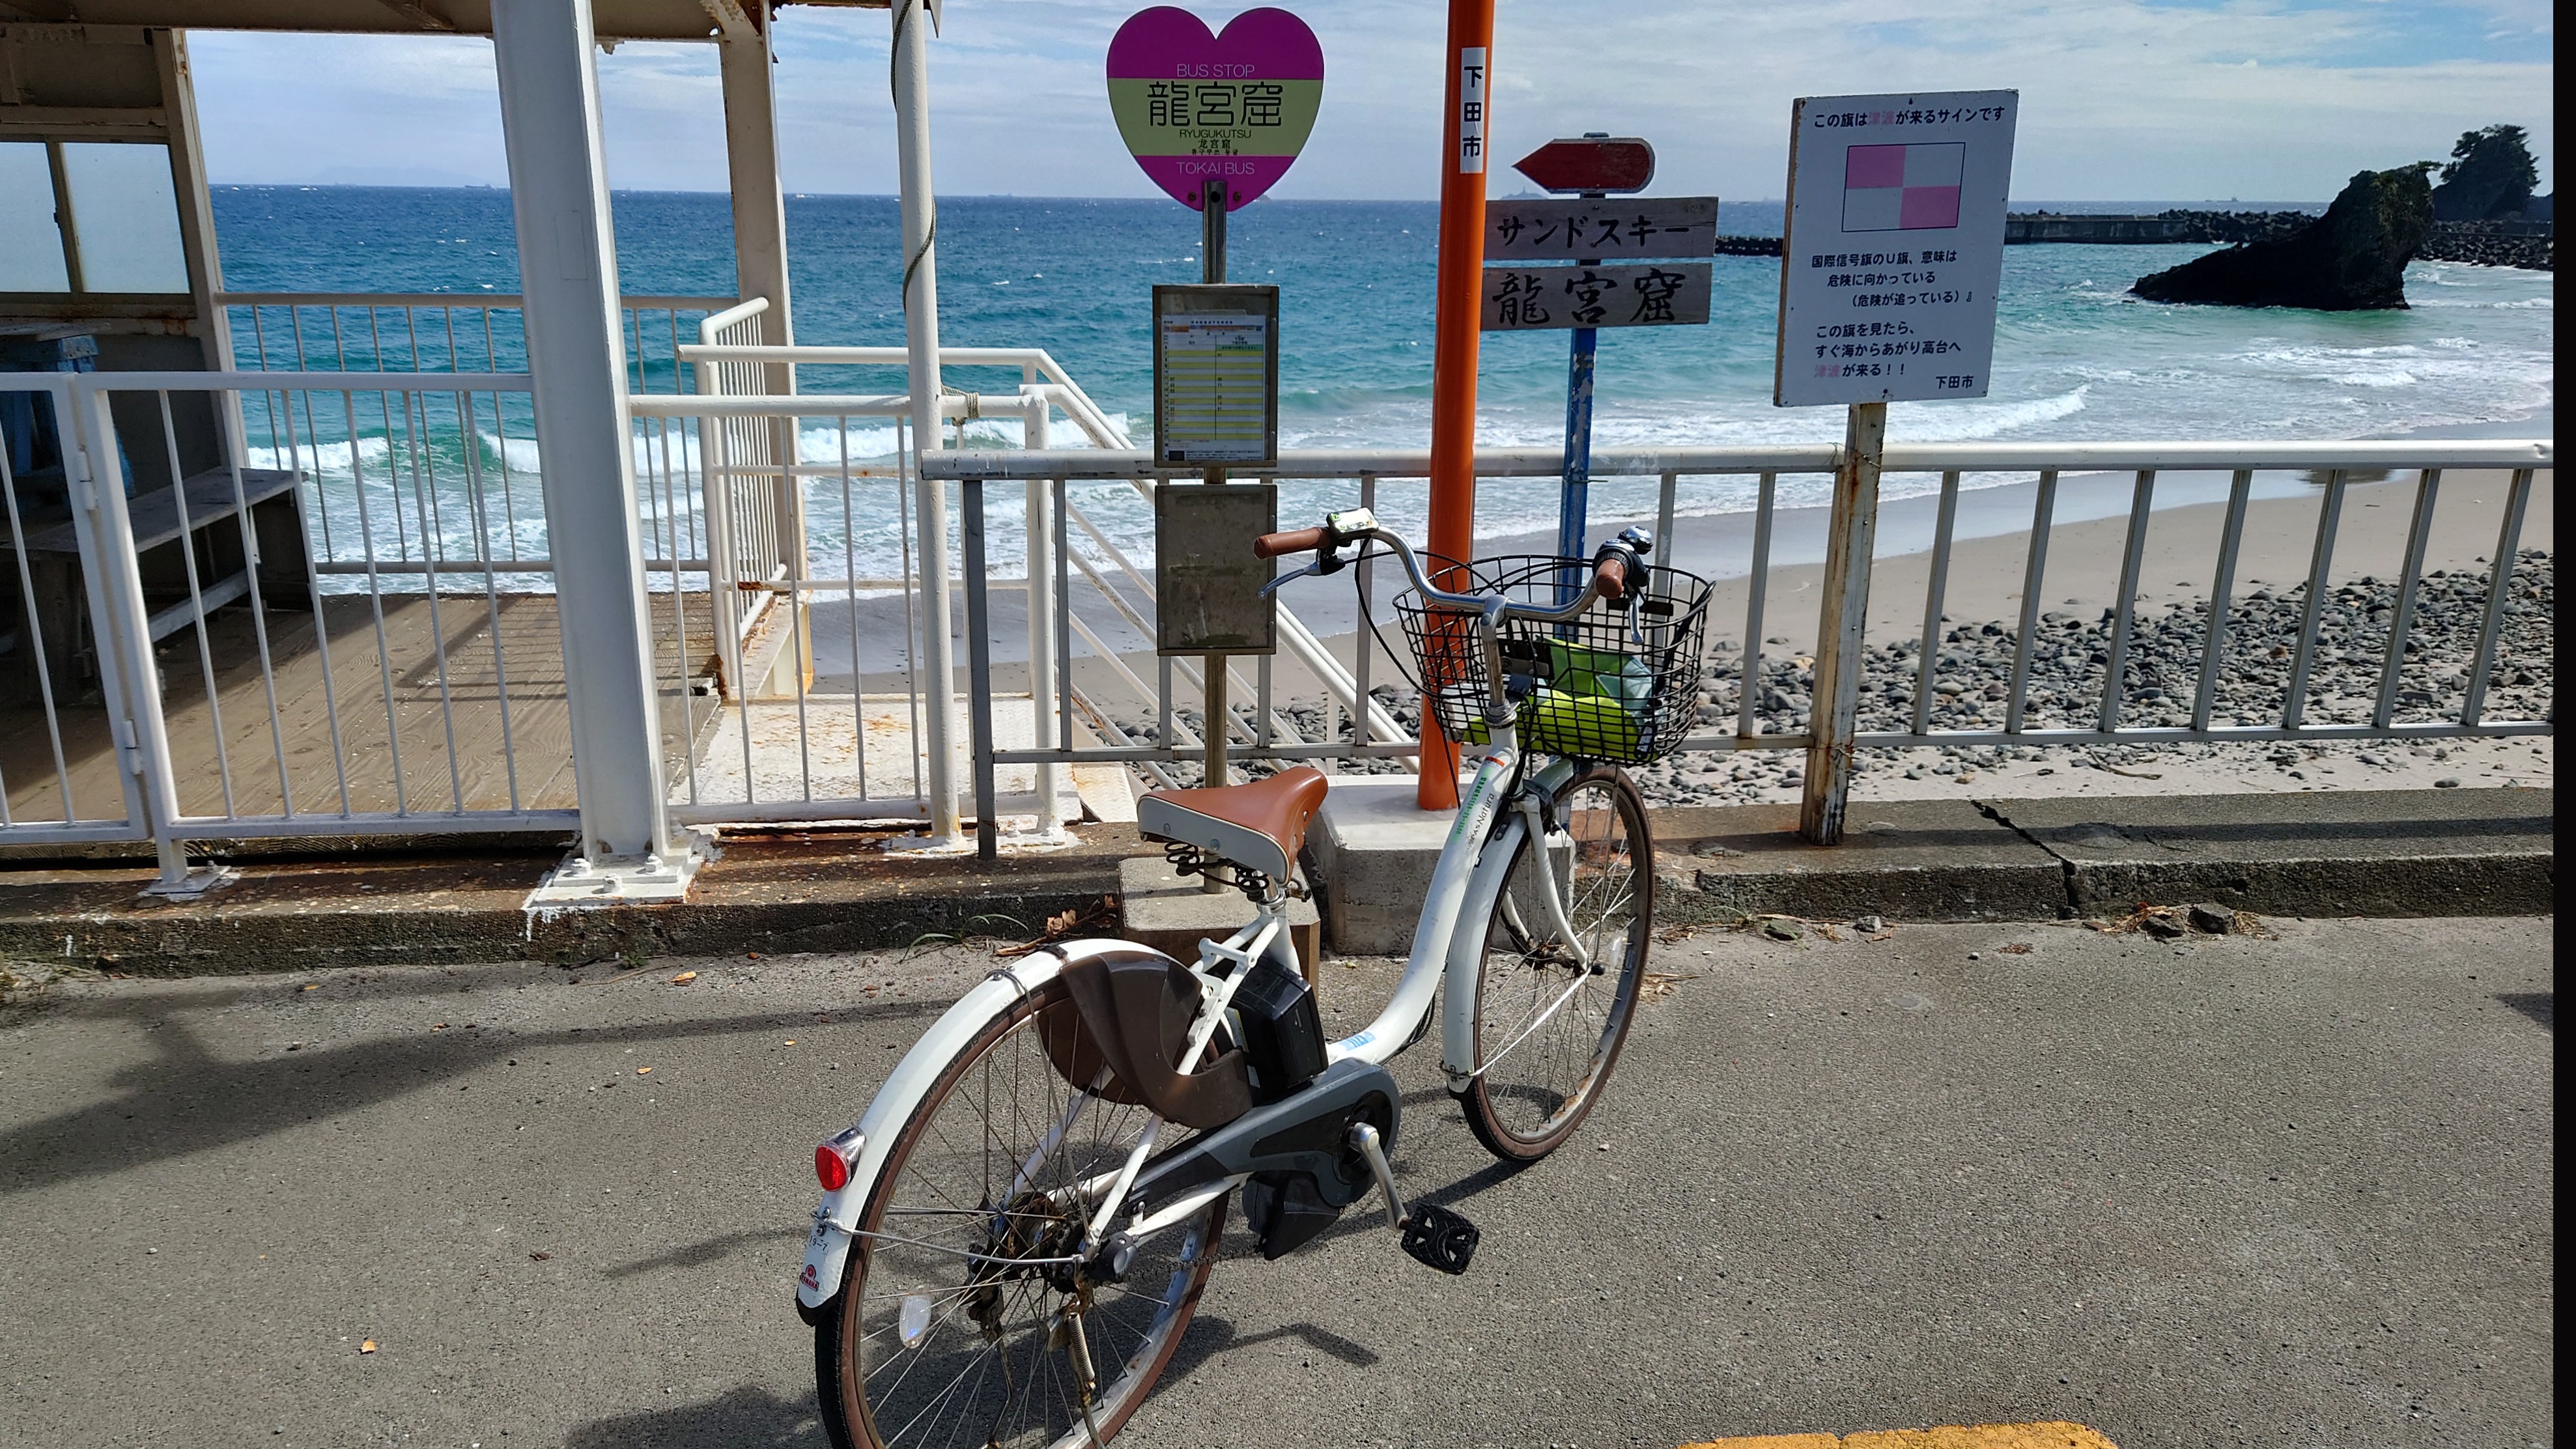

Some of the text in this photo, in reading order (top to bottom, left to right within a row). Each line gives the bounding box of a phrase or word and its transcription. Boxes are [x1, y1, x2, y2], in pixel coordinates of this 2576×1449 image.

[1177, 64, 1255, 77] BUS STOP
[1147, 81, 1283, 126] 龍宮窟
[1462, 66, 1484, 158] 下田市
[1180, 129, 1251, 139] RYUGUKUTSU
[1176, 162, 1255, 175] TOKAI BUS
[1497, 215, 1690, 249] サンドスキー
[1827, 271, 1936, 287] 危険に向かっている
[1492, 268, 1686, 326] 龍宮窟
[1816, 320, 1914, 338] この旗を見たら、
[1815, 340, 1962, 359] すぐ海からあがり高台へ
[1935, 375, 1974, 389] 下田市
[1476, 793, 1495, 826] Natura
